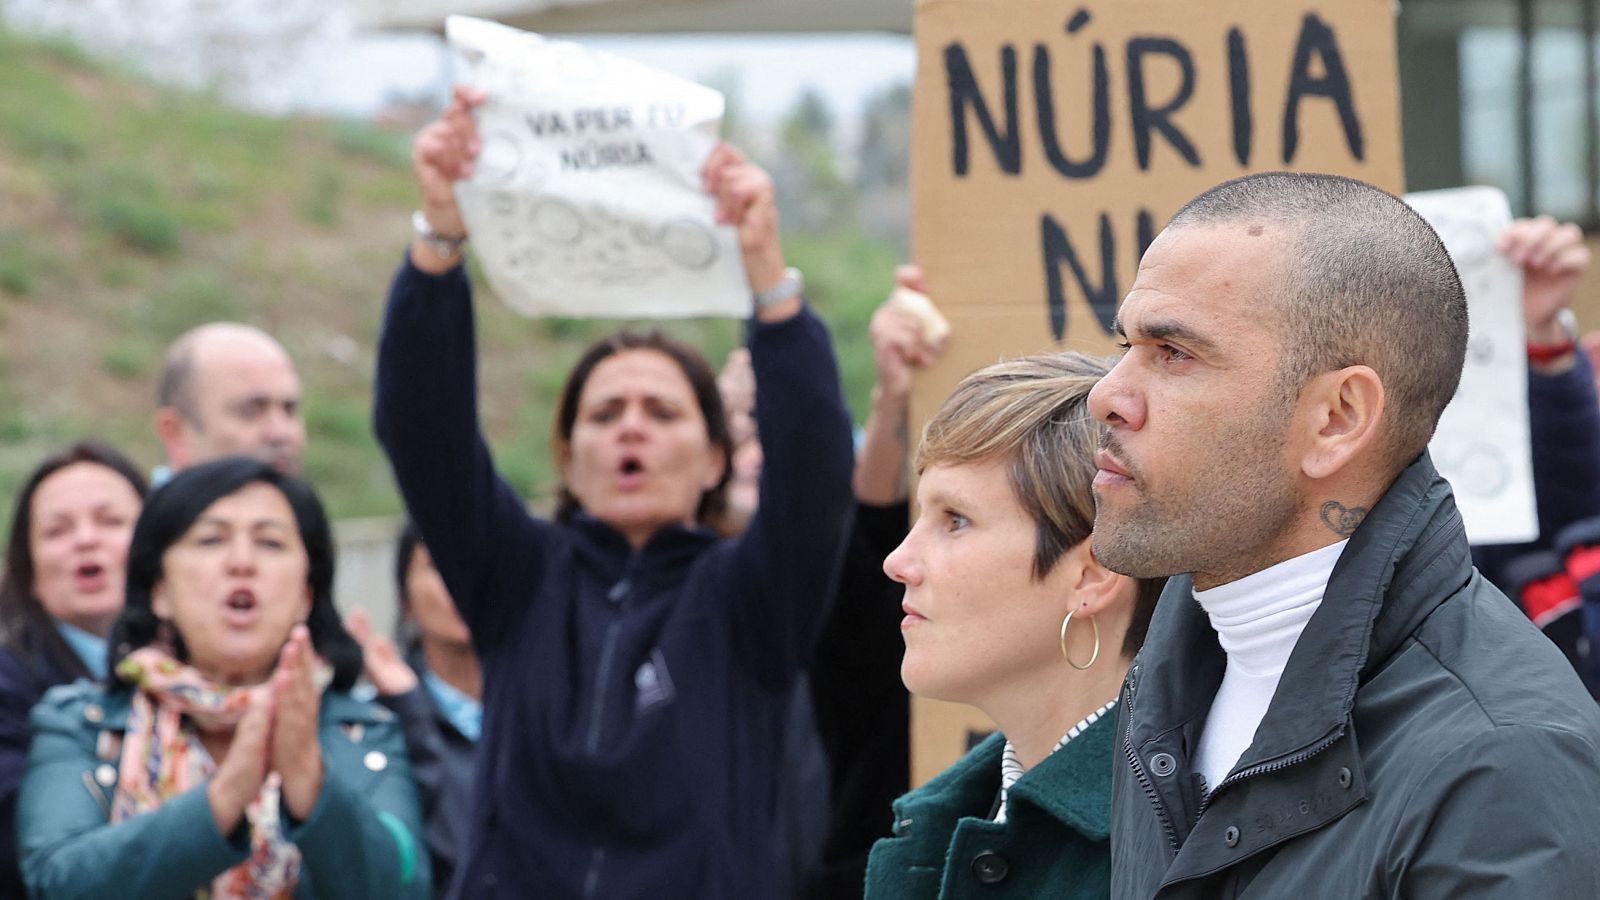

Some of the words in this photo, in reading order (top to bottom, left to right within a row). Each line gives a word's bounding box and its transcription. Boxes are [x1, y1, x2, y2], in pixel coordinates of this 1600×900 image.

[525, 111, 567, 136] VA
[573, 106, 632, 133] PER
[943, 8, 1364, 178] NÚRIA
